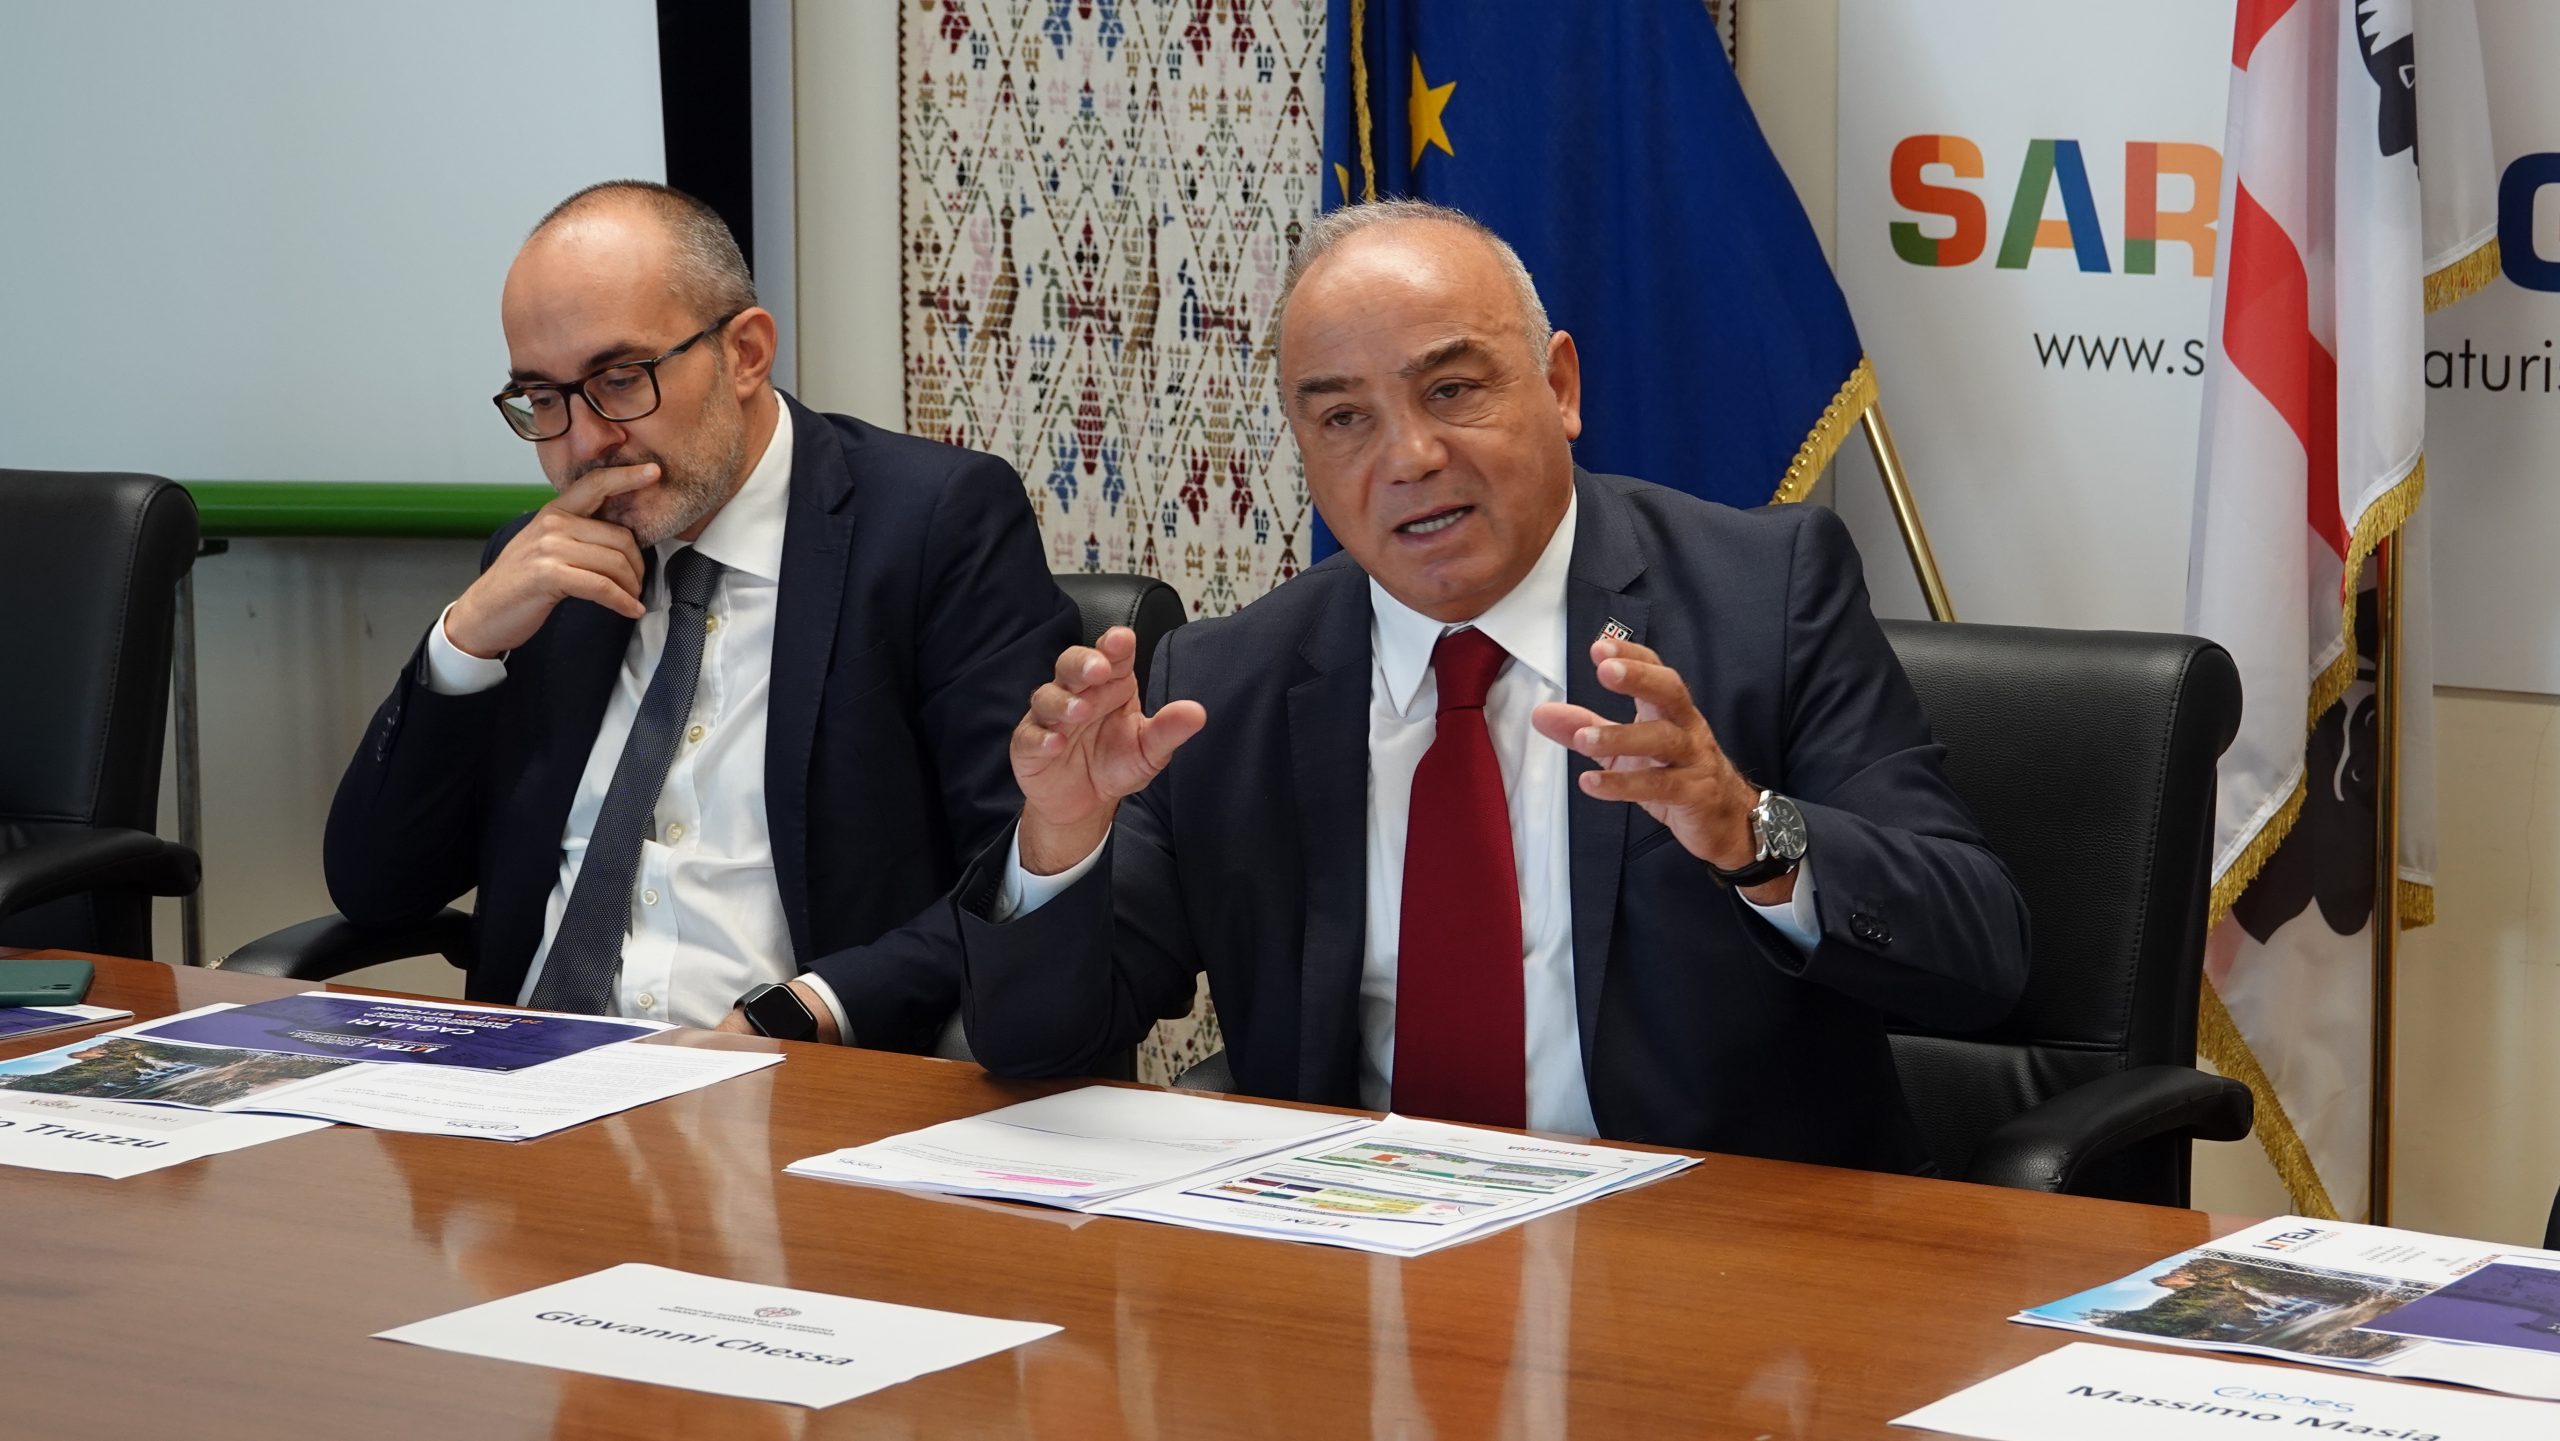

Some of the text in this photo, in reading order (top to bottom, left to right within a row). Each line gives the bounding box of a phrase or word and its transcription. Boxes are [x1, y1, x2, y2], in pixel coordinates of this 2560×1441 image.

[347, 1018, 475, 1035] CAGLIARI
[90, 1108, 179, 1123] CAGLIARI
[24, 1123, 170, 1148] Truzzu
[535, 1311, 854, 1366] Giovanni Chessa
[2067, 1385, 2441, 1441] Massimo Masia
